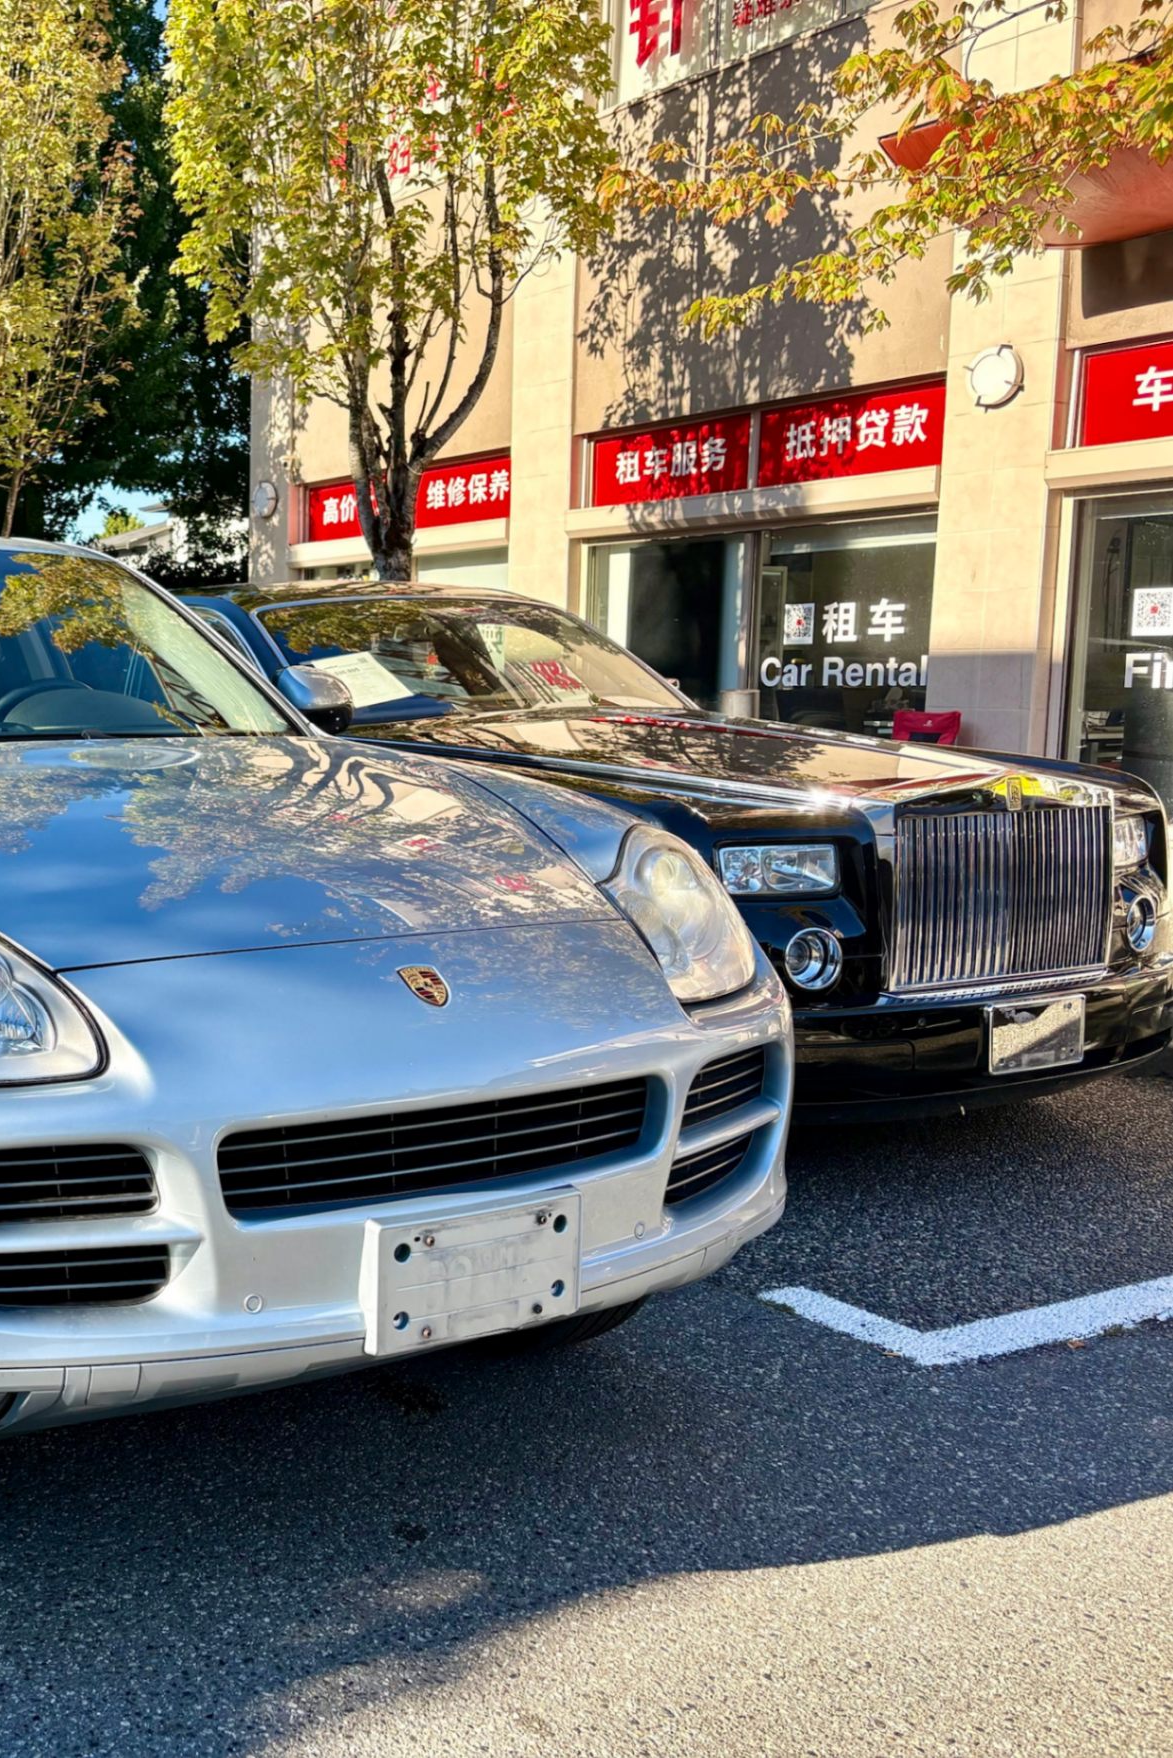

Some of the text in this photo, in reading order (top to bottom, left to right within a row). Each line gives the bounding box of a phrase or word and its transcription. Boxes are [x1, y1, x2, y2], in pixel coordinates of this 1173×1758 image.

[1132, 365, 1173, 411] 车
[785, 403, 929, 461] 抵押贷款
[615, 437, 727, 484] 租车服务
[426, 469, 510, 510] 维修保养
[822, 598, 906, 643] 租车
[760, 655, 928, 688] Car Rental
